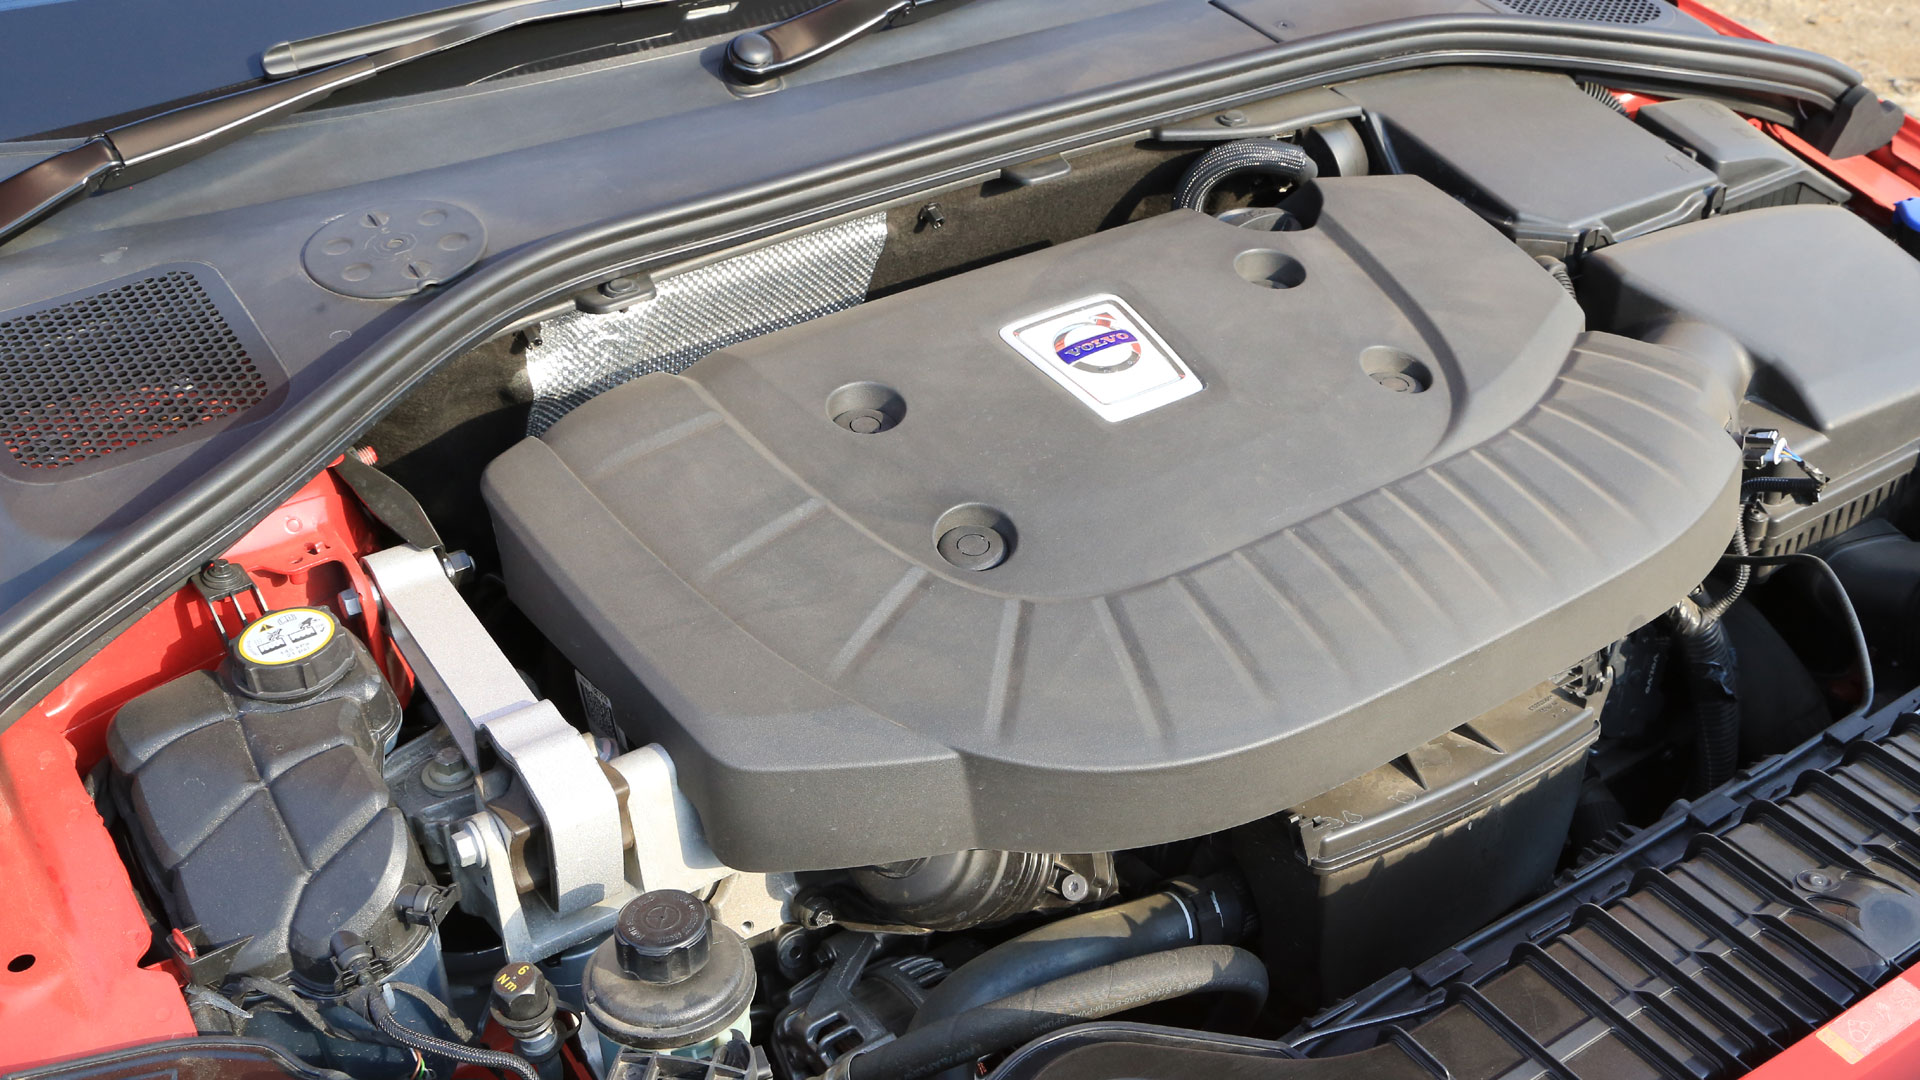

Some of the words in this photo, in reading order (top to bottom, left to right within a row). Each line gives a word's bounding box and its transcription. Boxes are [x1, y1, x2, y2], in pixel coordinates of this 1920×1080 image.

[1064, 332, 1129, 356] VOLVO
[517, 965, 530, 975] 6
[496, 973, 517, 992] Nm
